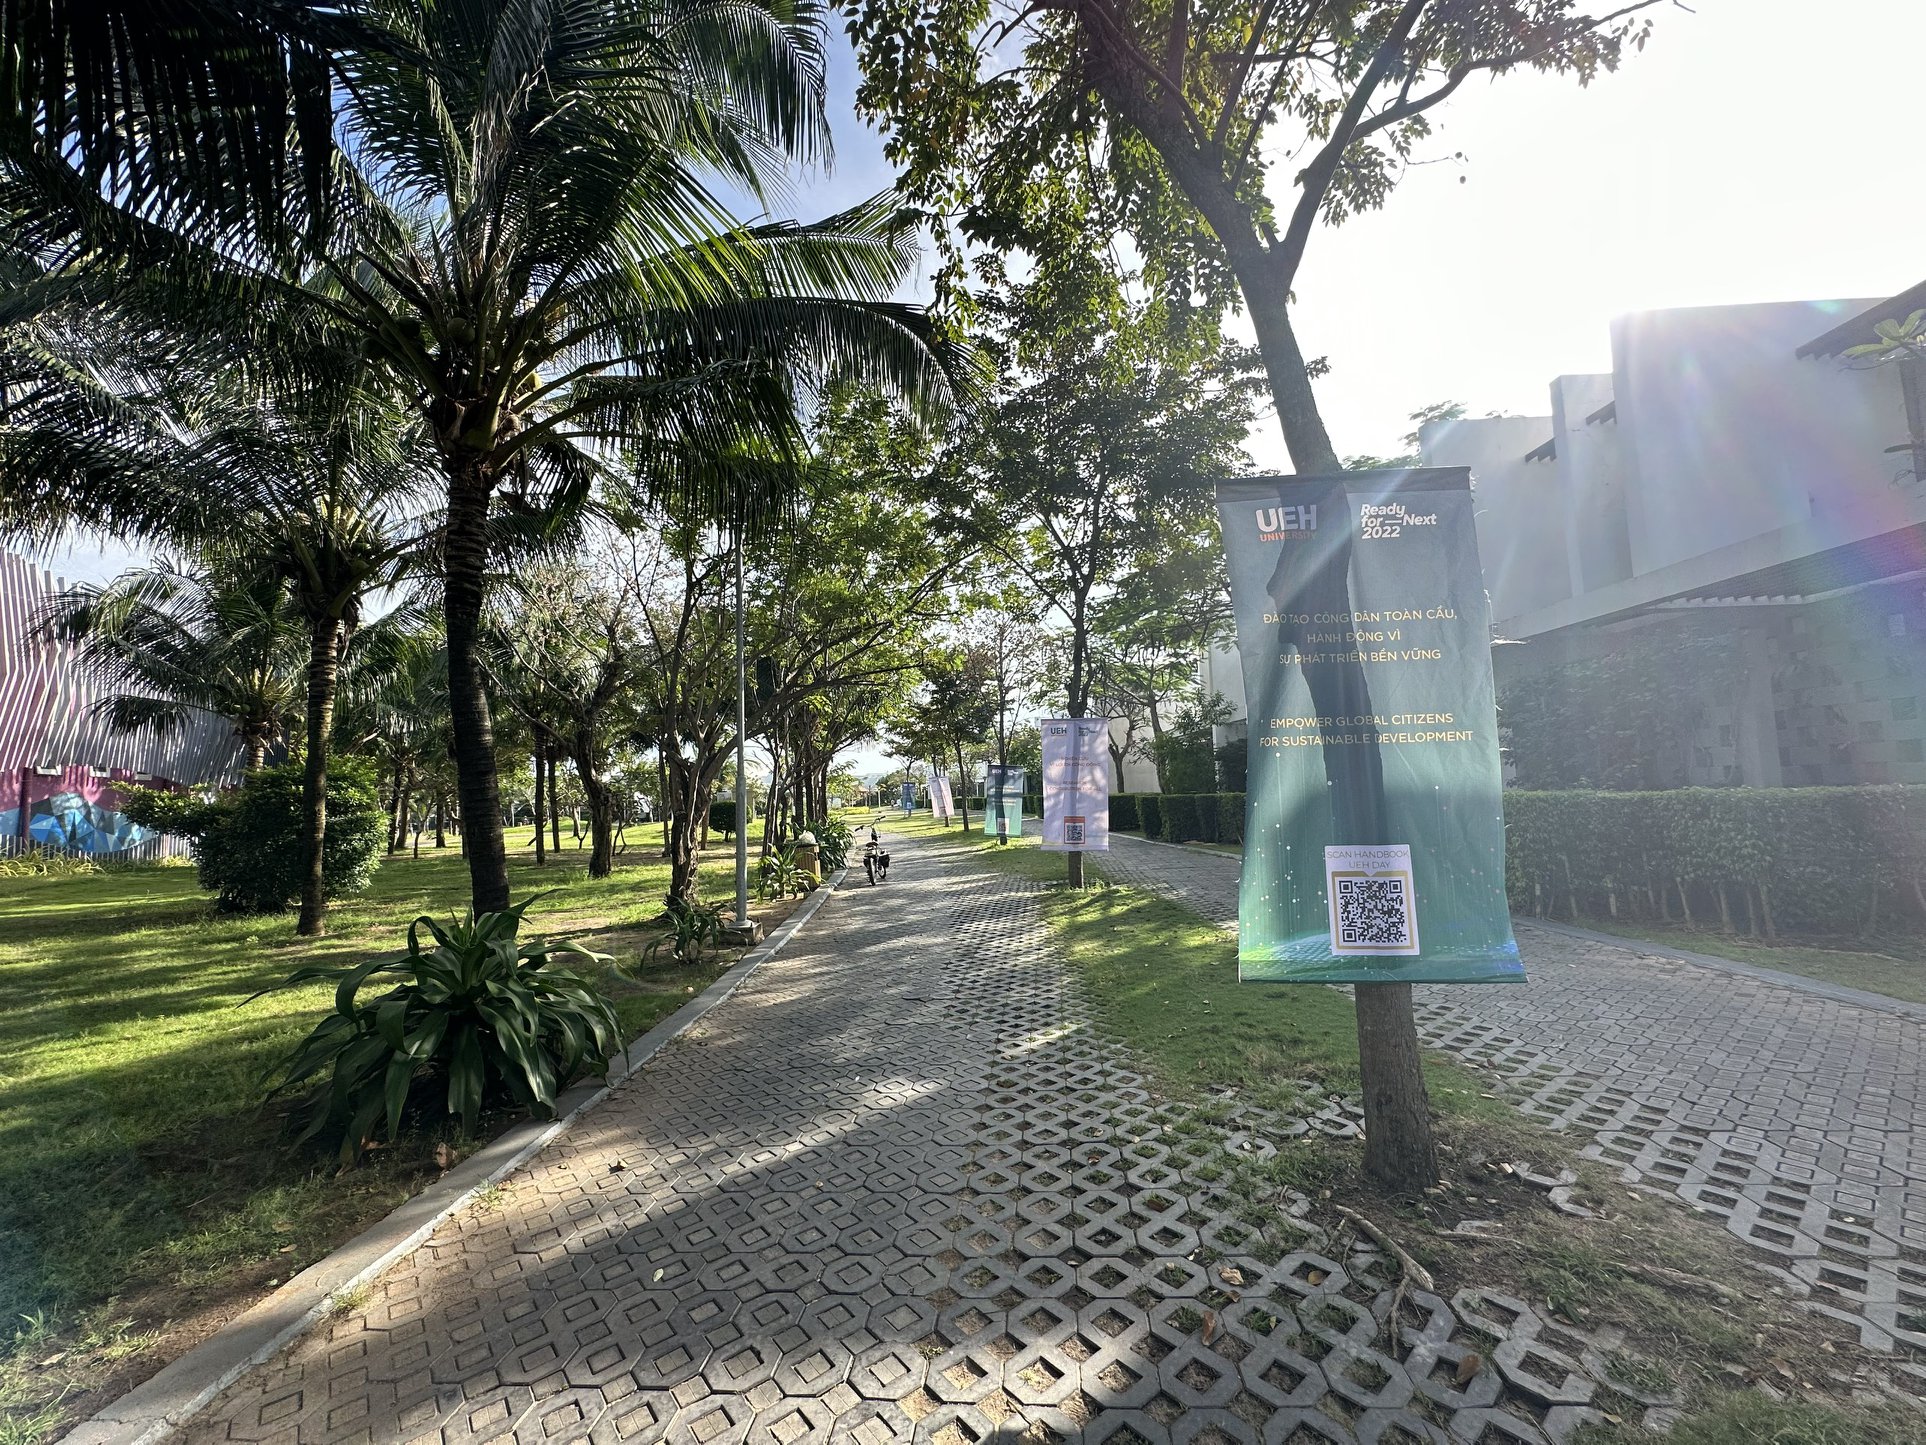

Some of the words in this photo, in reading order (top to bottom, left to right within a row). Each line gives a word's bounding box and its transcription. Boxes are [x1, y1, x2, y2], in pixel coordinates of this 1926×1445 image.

[1360, 503, 1406, 518] Ready
[1255, 504, 1317, 533] UEH
[1361, 515, 1383, 528] for
[1402, 513, 1438, 526] Next
[1259, 531, 1317, 543] UNIVERSITY
[1361, 526, 1401, 540] 2022
[1263, 611, 1287, 624] ĐÀO
[1288, 614, 1310, 626] TẠO
[1313, 611, 1349, 625] CÔNG
[1354, 610, 1380, 623] DÂN
[1384, 609, 1423, 622] TOÀN
[1307, 631, 1342, 644] HÀNH
[1346, 628, 1384, 645] ĐỘNG
[1387, 628, 1402, 642] VÌ
[1279, 654, 1291, 667] SỰ
[1294, 651, 1326, 665] PHÁT
[1329, 648, 1368, 664] TRIỂN
[1371, 648, 1397, 662] BỀN
[1401, 647, 1442, 661] VỮNG
[1270, 717, 1332, 729] EMPOWER
[1336, 715, 1388, 727] GLOBAL
[1391, 713, 1454, 725] CITIZENS
[1050, 727, 1067, 735] UEH
[1259, 737, 1279, 747] FOR
[1282, 734, 1371, 746] SUSTAINABLE
[1374, 731, 1474, 743] DEVELOPMENT
[1326, 850, 1352, 859] SCAN
[1354, 850, 1409, 859] HANDBOOK
[1348, 861, 1370, 869] UEH
[1372, 861, 1391, 869] DAY
